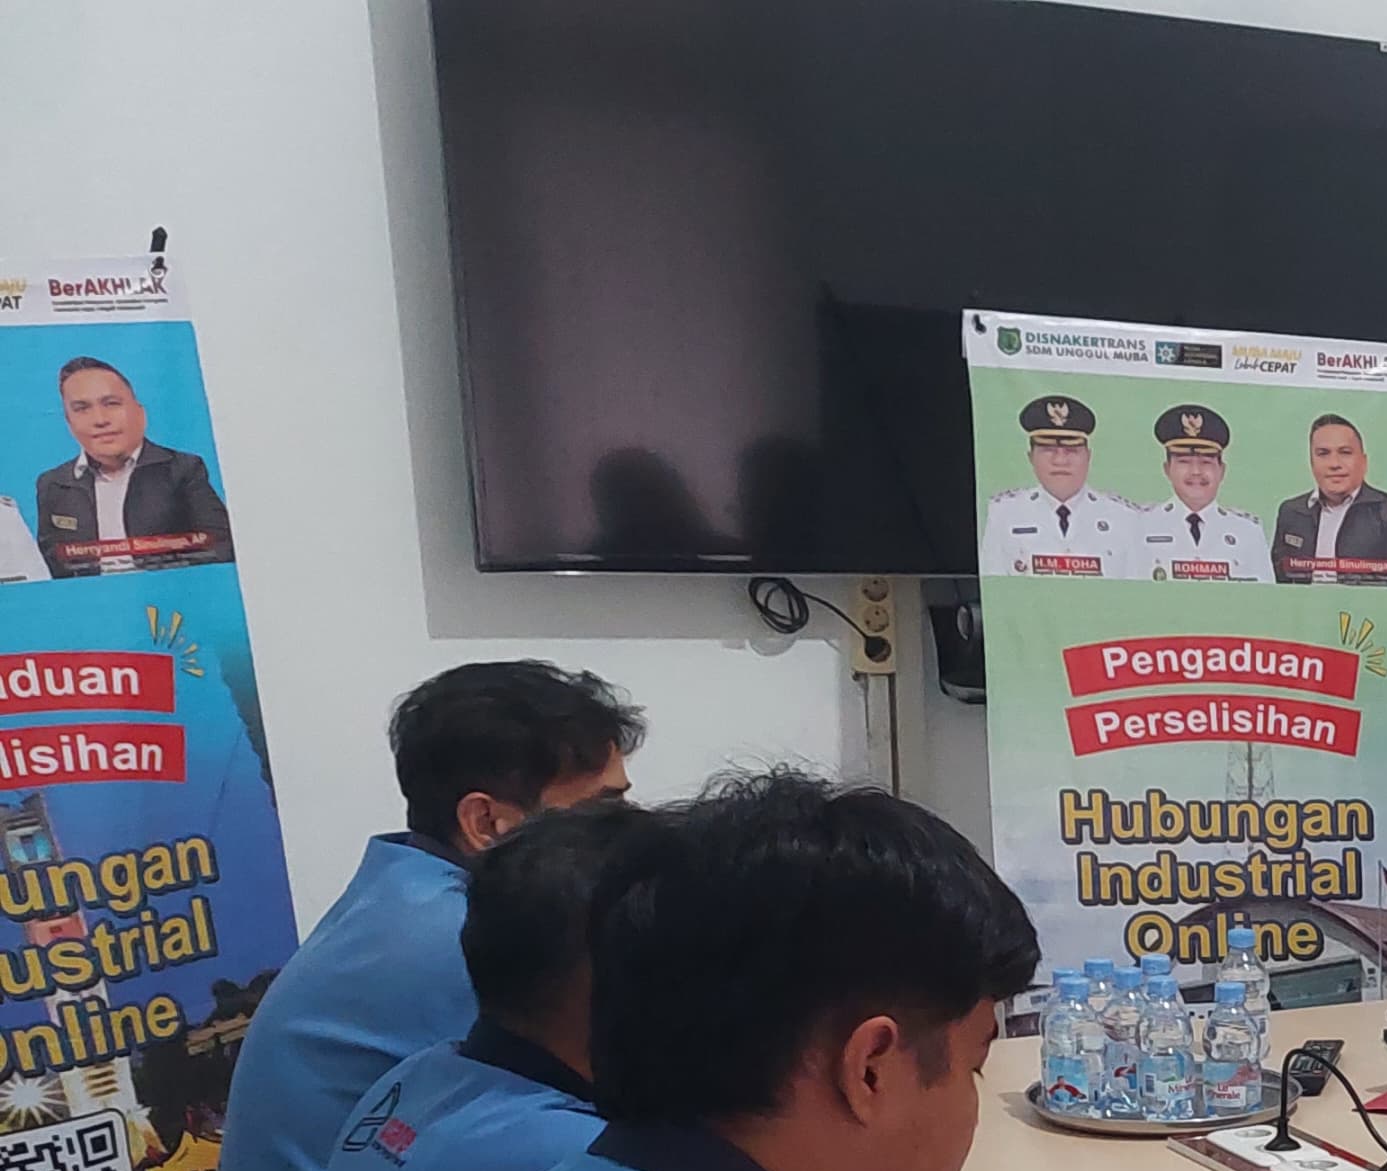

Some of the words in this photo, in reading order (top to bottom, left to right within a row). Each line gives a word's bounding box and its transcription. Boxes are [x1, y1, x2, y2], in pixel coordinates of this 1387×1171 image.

[0, 295, 22, 310] AT
[1025, 332, 1146, 351] DISNAKERTRANS
[1025, 345, 1053, 357] SDM
[1113, 351, 1149, 363] MUBA
[1259, 361, 1298, 374] CEPAT
[1064, 558, 1099, 570] TOHA
[1174, 562, 1228, 574] ROHMAN
[1102, 643, 1324, 682] Pengaduan
[1094, 701, 1336, 745] Perselisihan
[1060, 790, 1371, 848] Hubungan
[1078, 851, 1360, 903] Industrial
[0, 994, 180, 1074] nline
